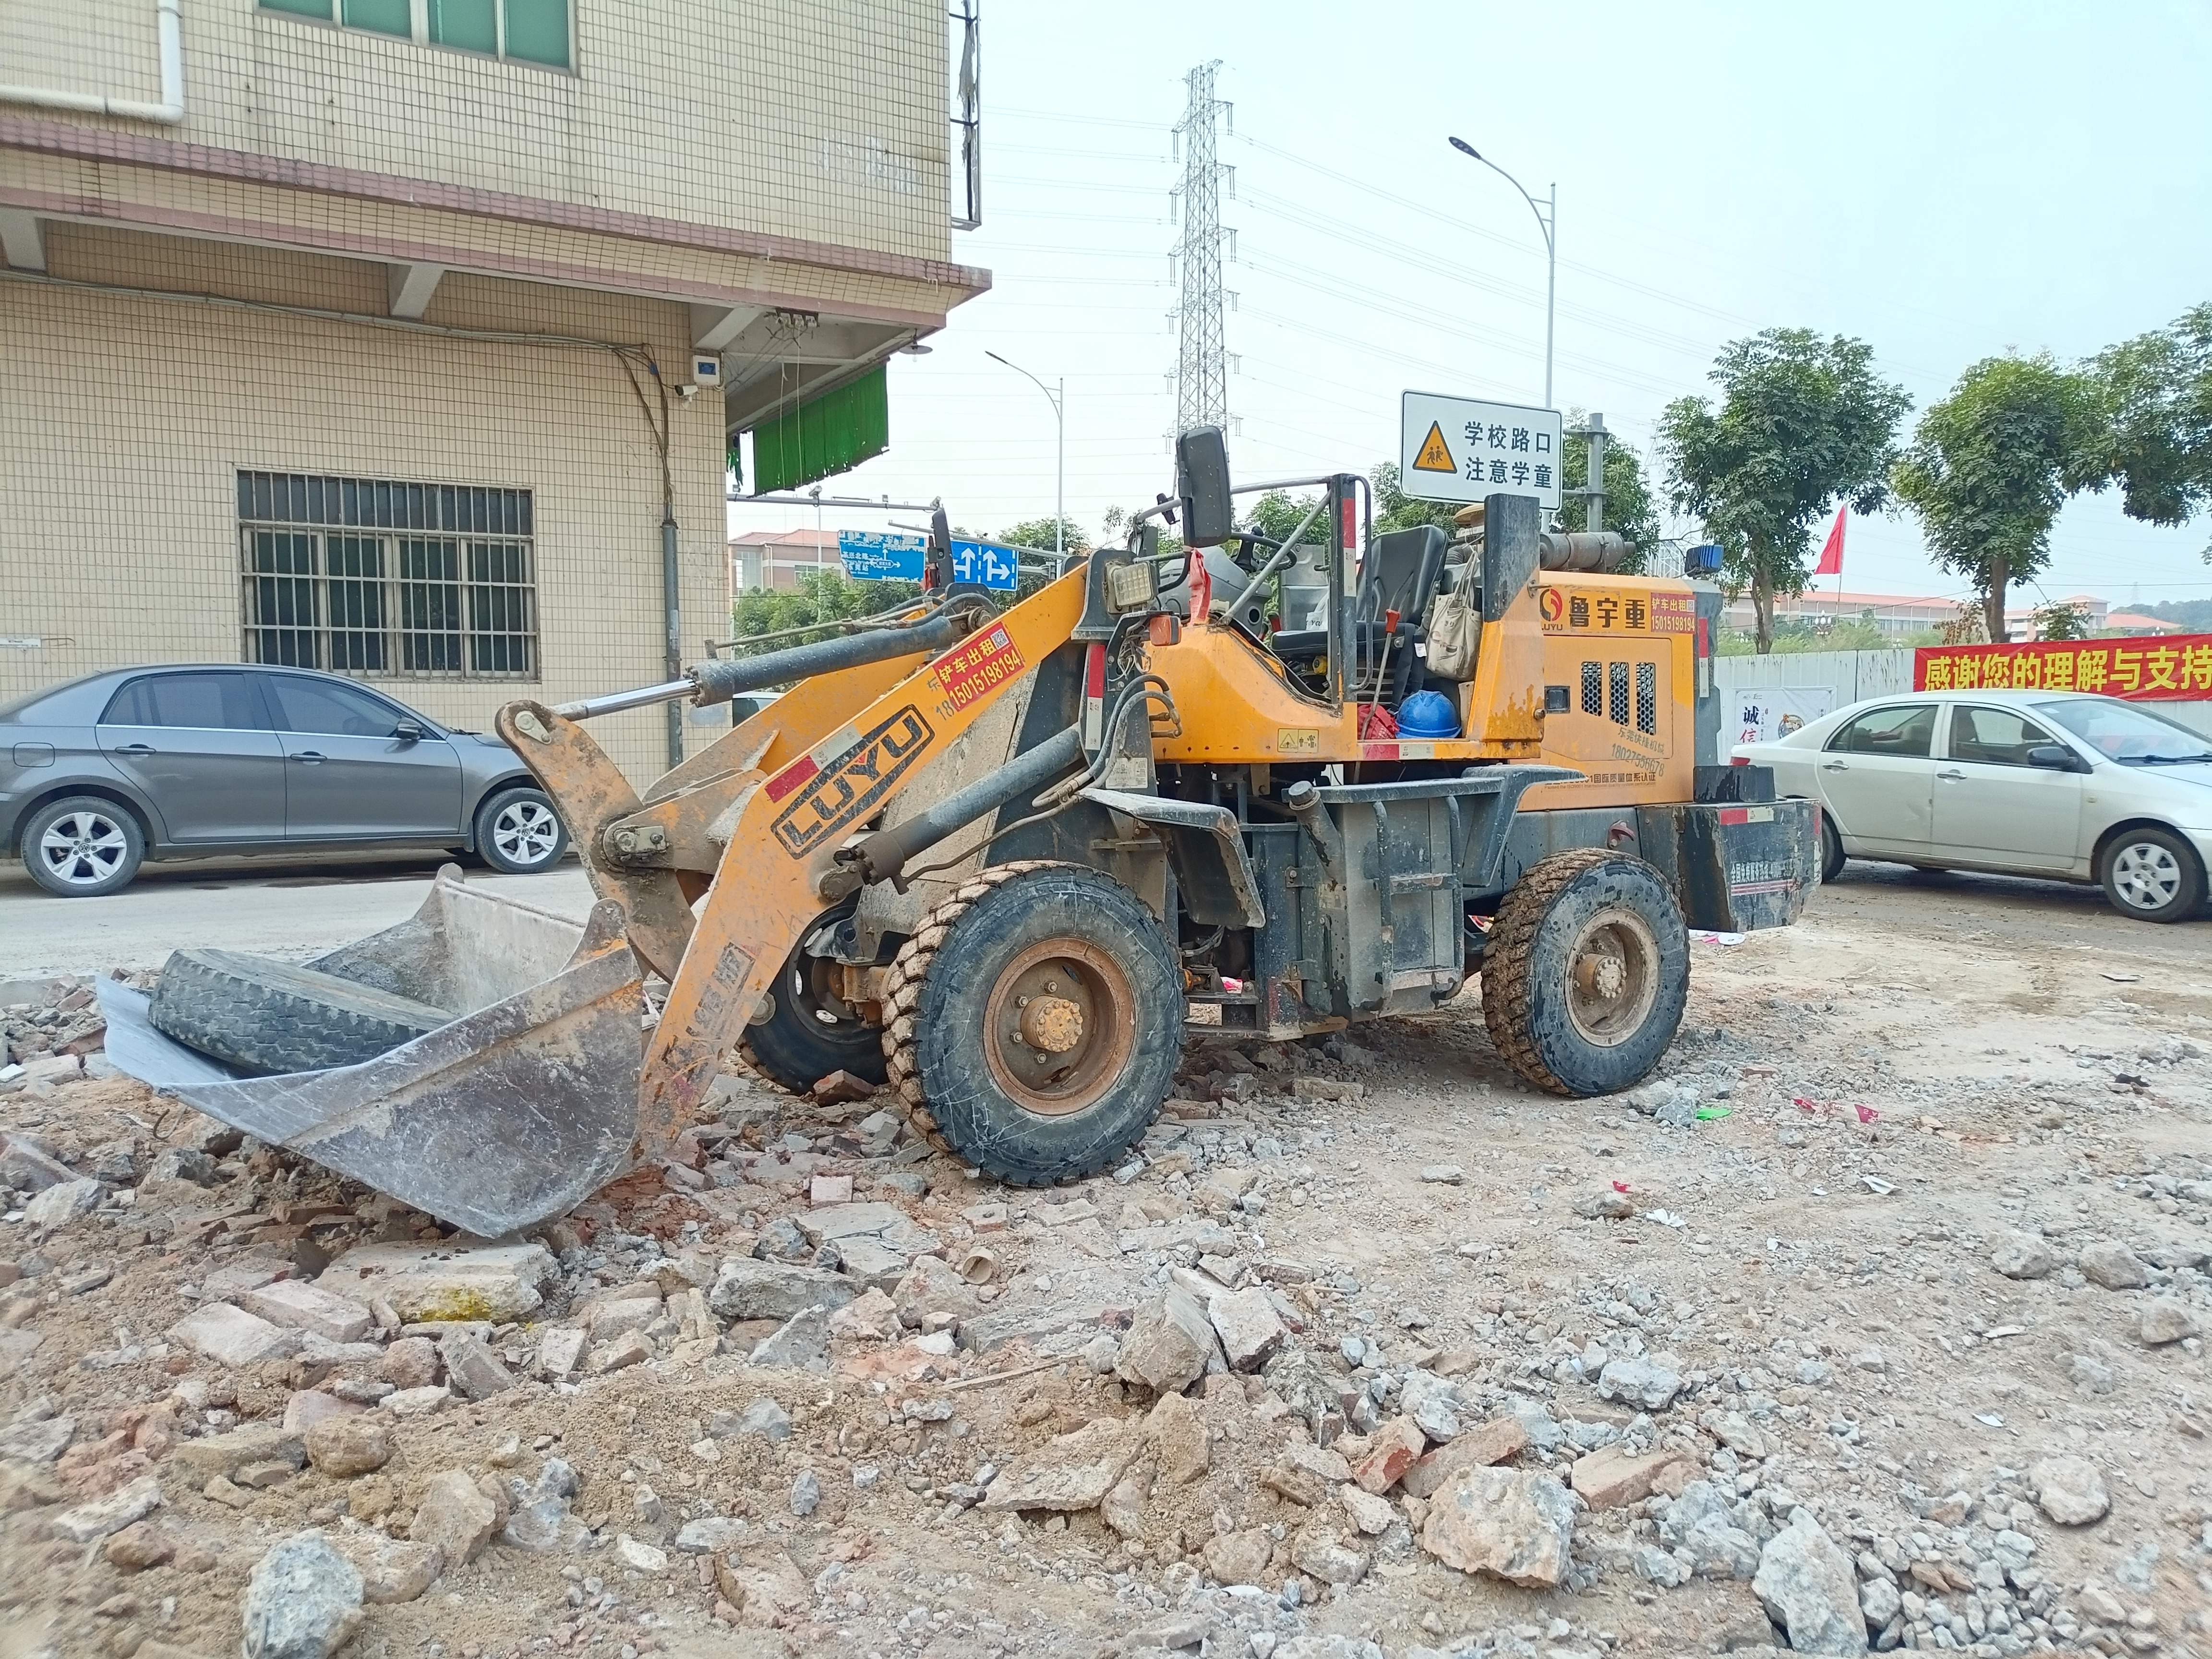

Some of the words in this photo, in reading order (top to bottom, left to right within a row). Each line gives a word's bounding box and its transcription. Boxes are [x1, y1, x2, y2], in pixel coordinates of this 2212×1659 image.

[1465, 421, 1551, 454] 学校路口
[1465, 457, 1552, 489] 注意学童
[1569, 595, 1645, 629] 鲁宇重
[1651, 598, 1687, 612] 铲车出租
[1651, 615, 1695, 632] 15015198194
[938, 637, 997, 684] 铲车出租
[1924, 644, 2212, 692] 感谢您的理解与支持
[949, 649, 1021, 708] 15015198194
[1612, 743, 1665, 777] 18027556678
[781, 714, 923, 847] LUYU
